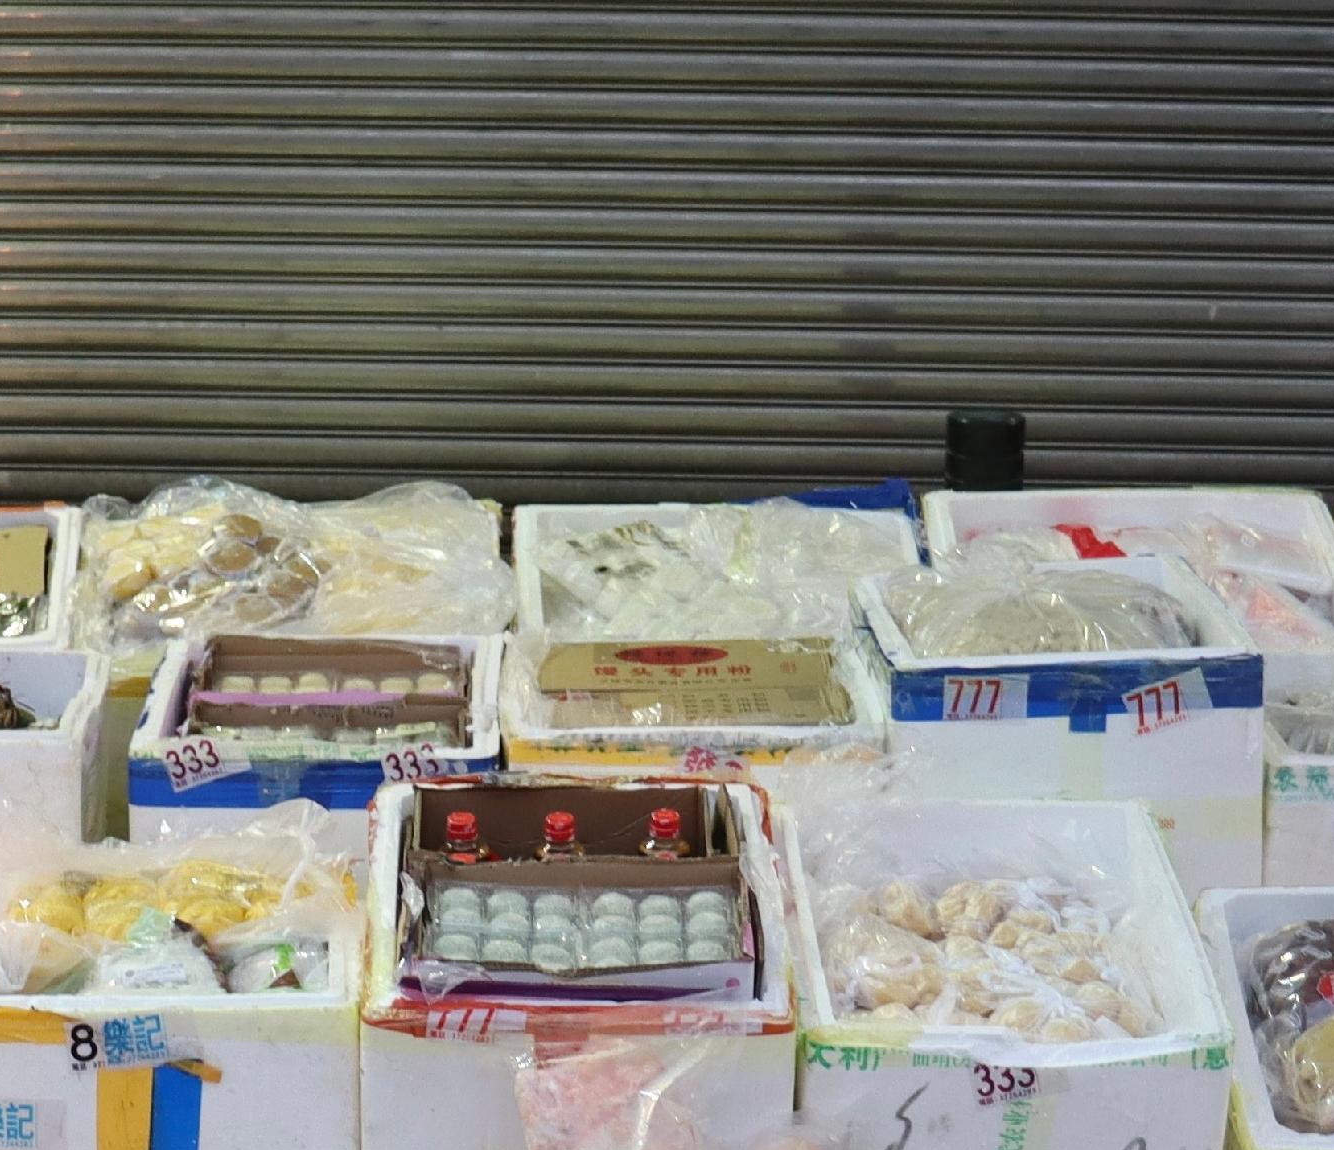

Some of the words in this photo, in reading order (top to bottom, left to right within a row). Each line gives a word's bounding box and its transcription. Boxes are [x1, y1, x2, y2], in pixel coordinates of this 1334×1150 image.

[948, 679, 1003, 714] 777
[1126, 681, 1181, 727] 777
[166, 740, 220, 779] 333
[70, 1023, 98, 1062] 8
